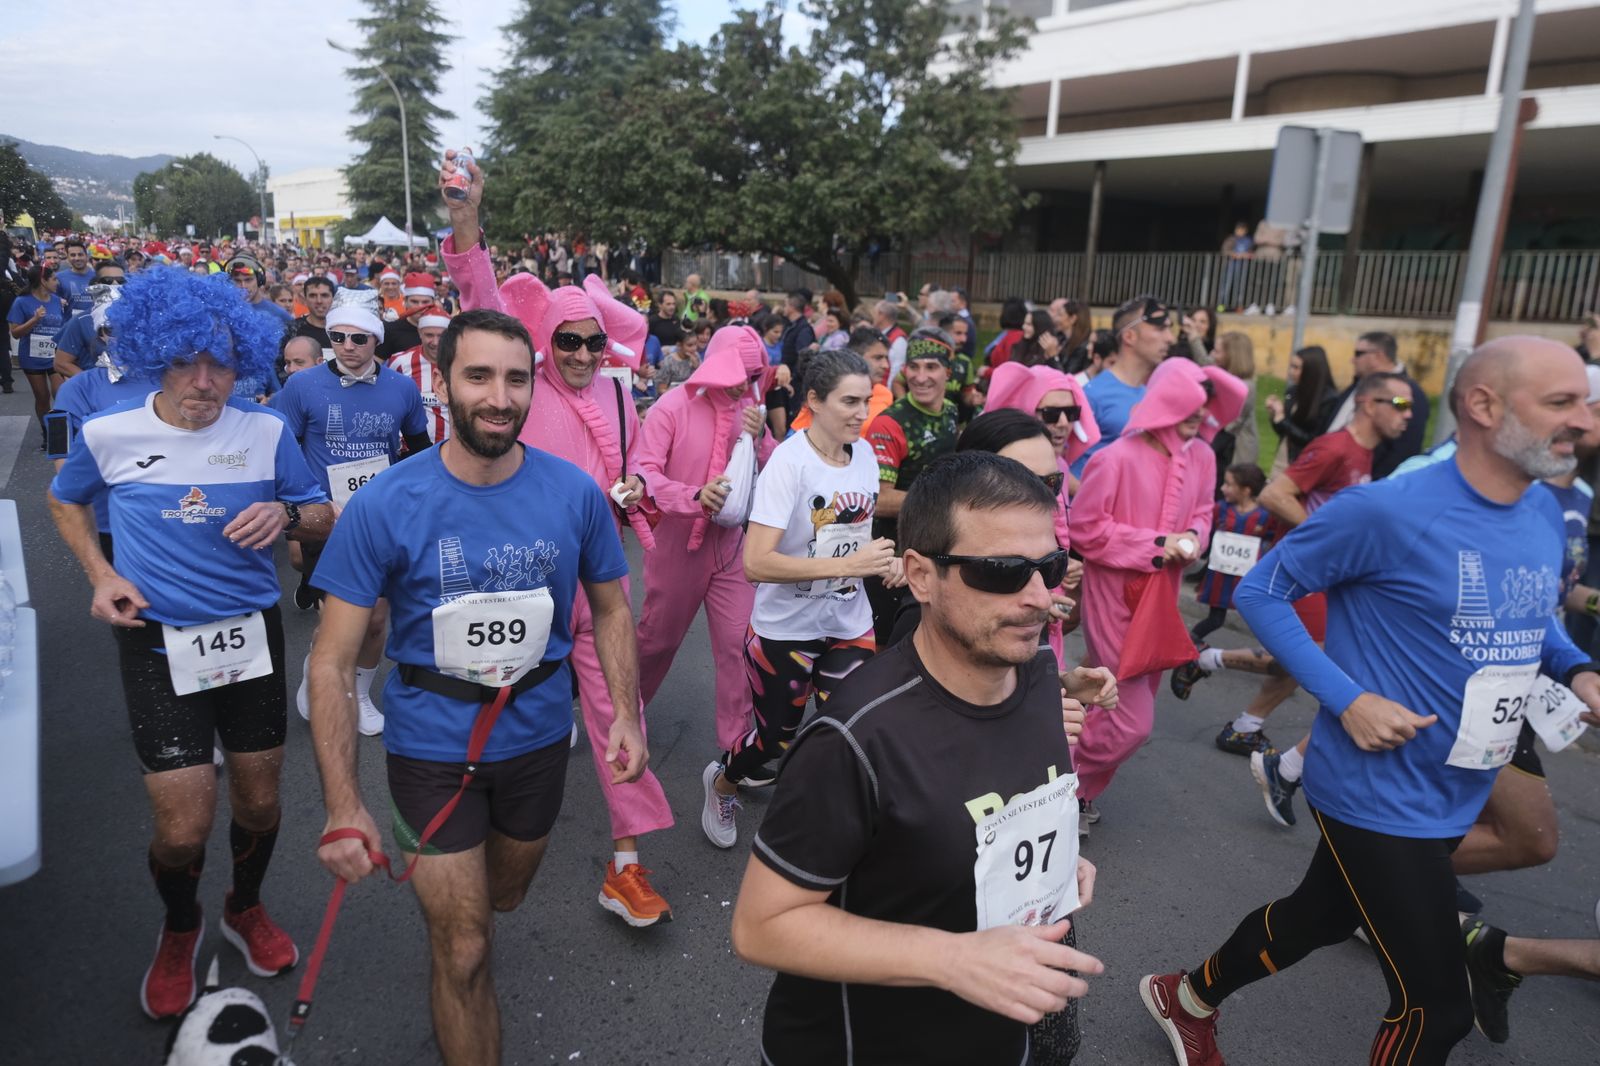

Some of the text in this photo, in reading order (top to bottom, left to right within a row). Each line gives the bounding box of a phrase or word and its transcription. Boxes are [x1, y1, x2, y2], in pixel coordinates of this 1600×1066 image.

[325, 441, 344, 449] SAN
[330, 448, 384, 458] CORDOBESA
[347, 472, 375, 491] 86
[832, 541, 859, 558] 423
[1220, 544, 1251, 559] 1045
[468, 597, 505, 605] SILVESTRE
[1450, 619, 1495, 629] XXXVIII
[466, 619, 527, 647] 589
[1450, 629, 1490, 644] SAN
[191, 626, 246, 658] 145
[1539, 682, 1566, 715] 205
[1008, 796, 1048, 818] SILVESTRE
[1014, 830, 1058, 882] 97
